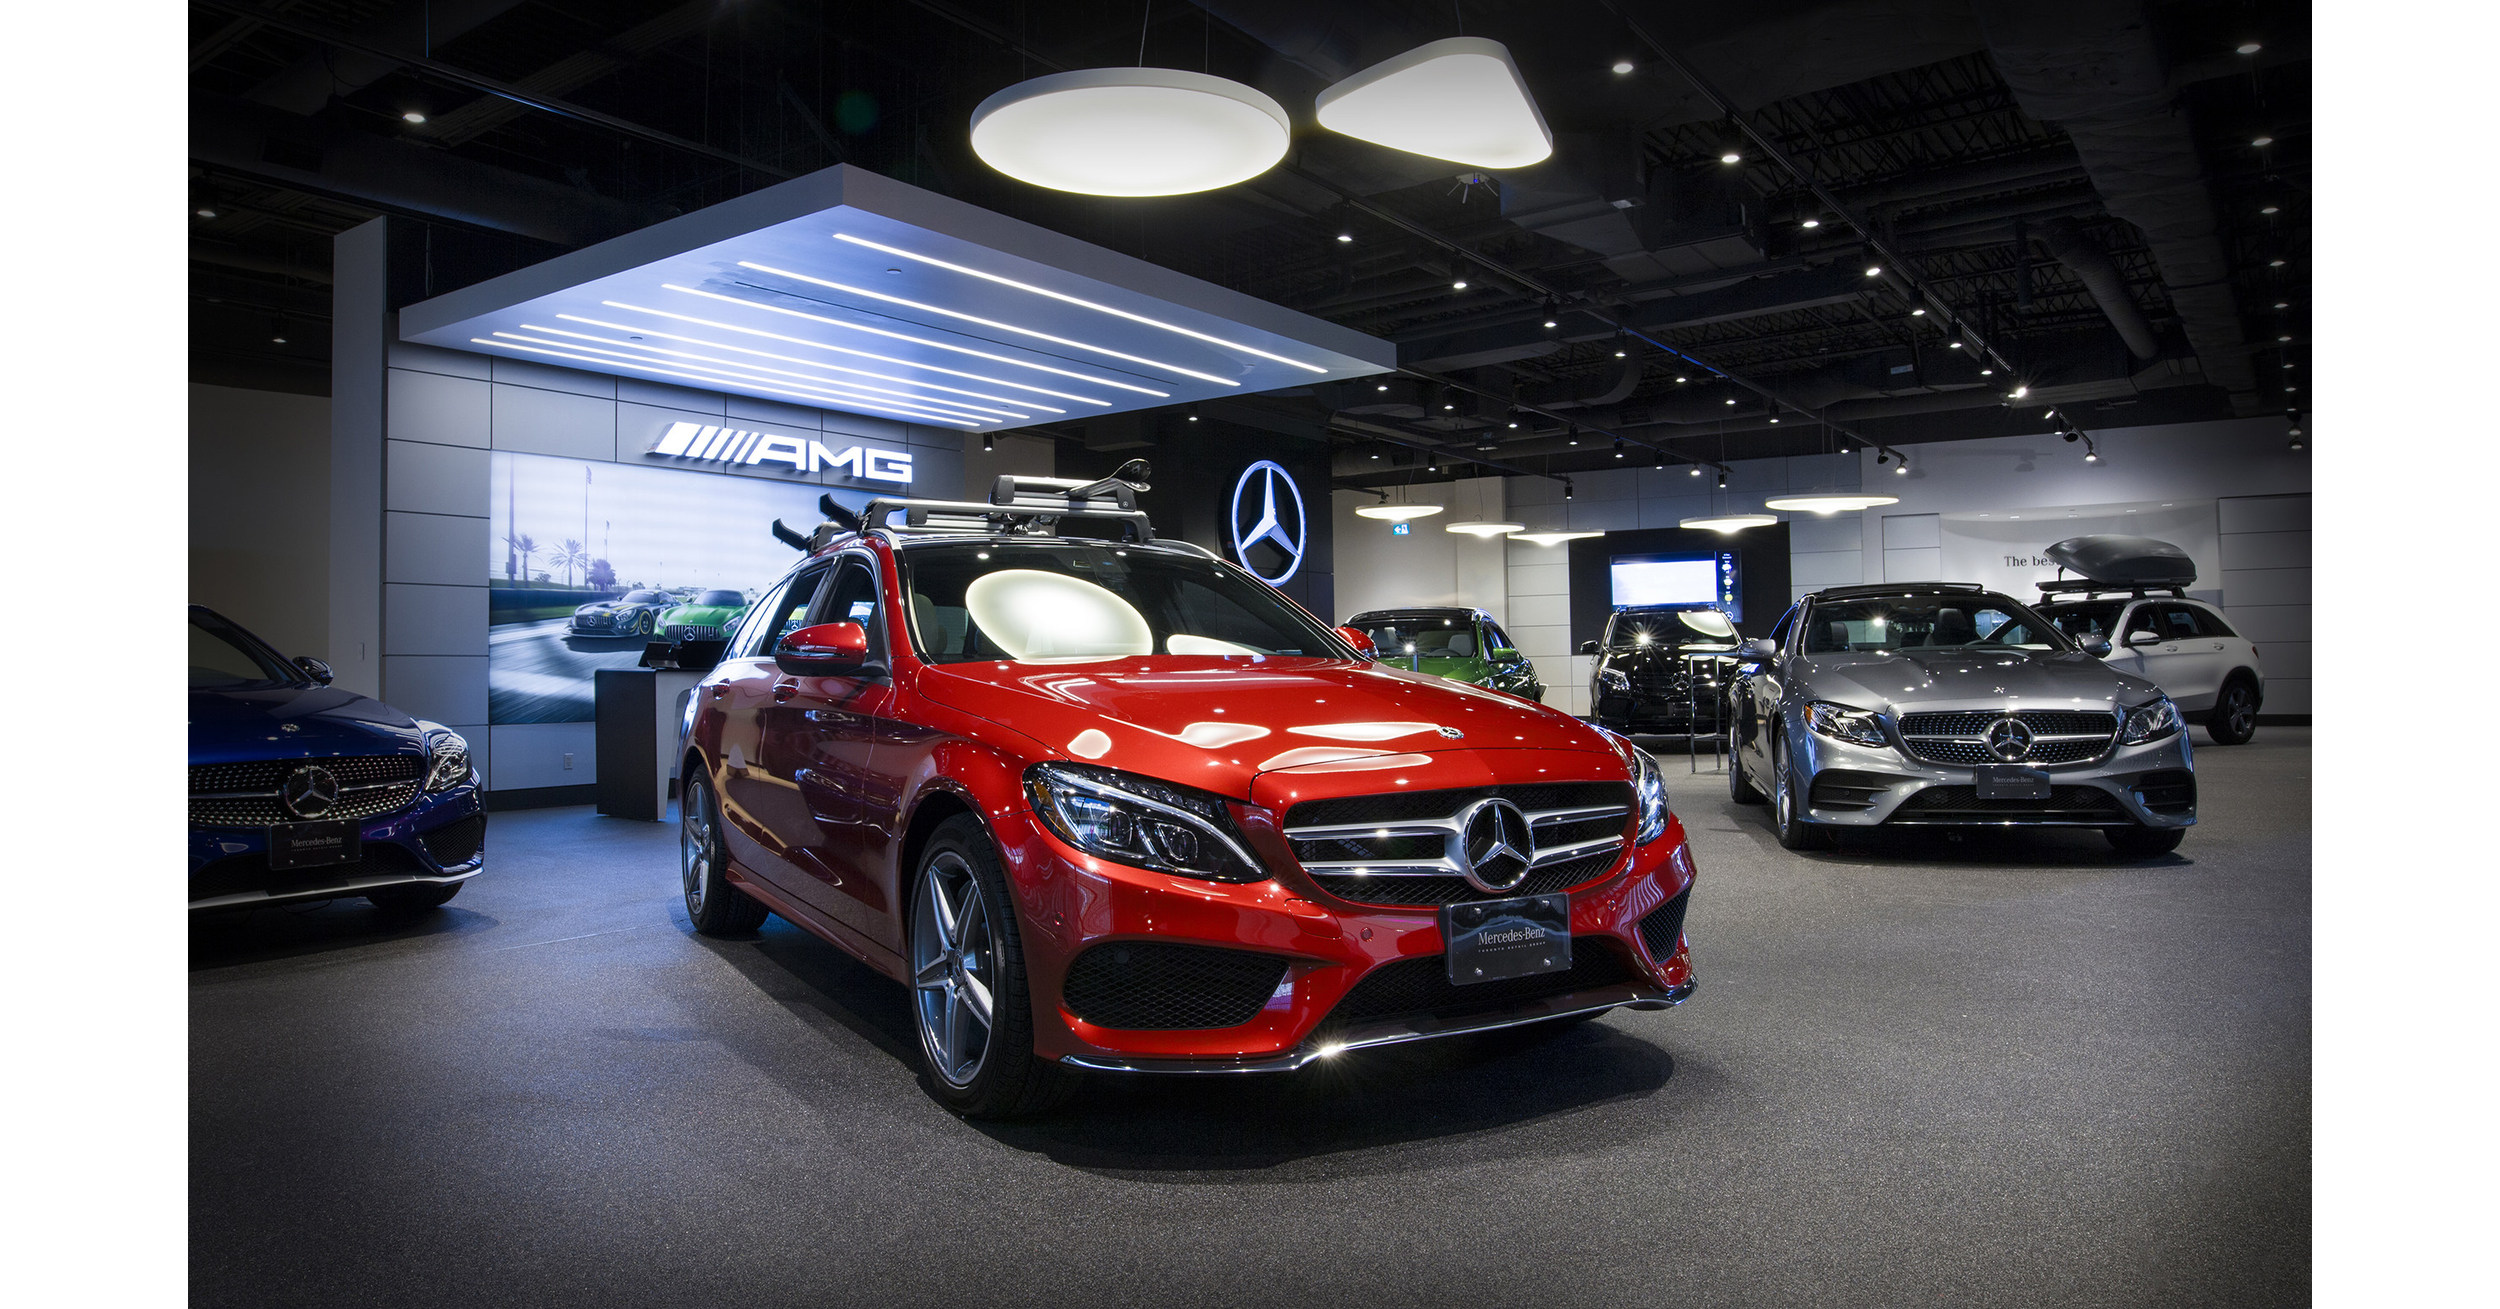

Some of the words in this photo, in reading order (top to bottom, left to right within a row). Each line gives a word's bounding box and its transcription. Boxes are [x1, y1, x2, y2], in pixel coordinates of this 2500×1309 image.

[746, 434, 912, 483] AMG
[2004, 556, 2027, 567] The
[2032, 556, 2060, 566] bes
[291, 836, 343, 848] Mercedes-Benz
[1478, 926, 1546, 946] Mercedes-Benz
